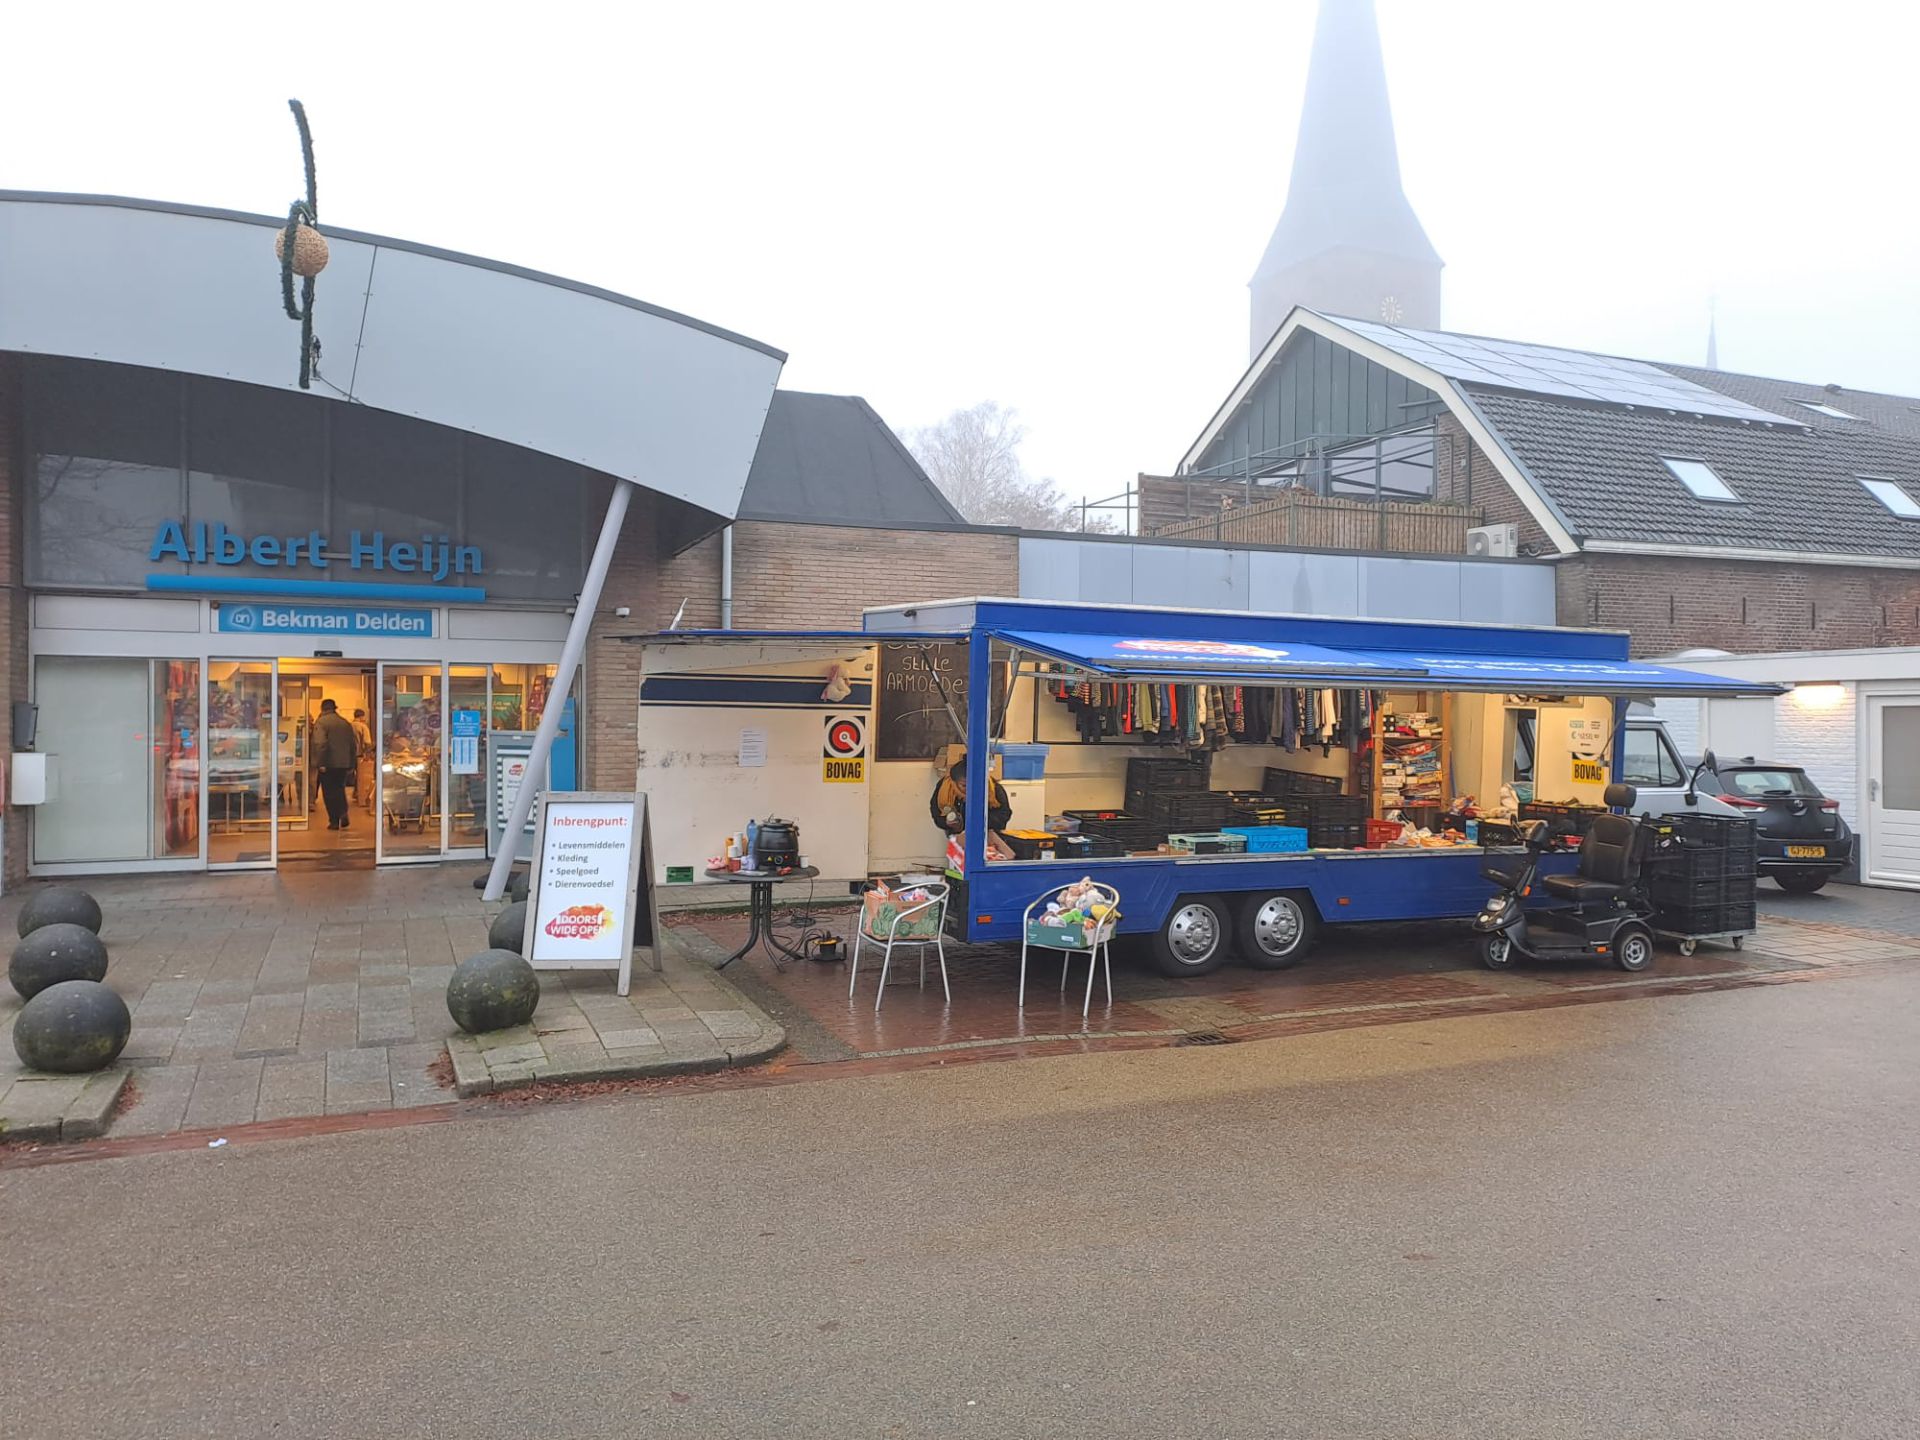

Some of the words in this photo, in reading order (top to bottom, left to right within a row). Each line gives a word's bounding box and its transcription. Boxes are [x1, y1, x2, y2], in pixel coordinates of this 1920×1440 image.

[150, 519, 328, 568] Albert
[351, 530, 482, 581] Heijn
[262, 610, 348, 629] Bekman
[355, 612, 425, 632] Delden
[826, 761, 861, 779] BOVAG
[1574, 763, 1602, 781] BOVAG
[553, 816, 628, 829] Inbrengpunt:
[558, 841, 625, 850] Levensmiddelen
[557, 854, 588, 864] Kleding
[556, 867, 599, 877] Speelgoed
[555, 879, 614, 889] Dierenvoedsel
[550, 925, 577, 936] WIDE
